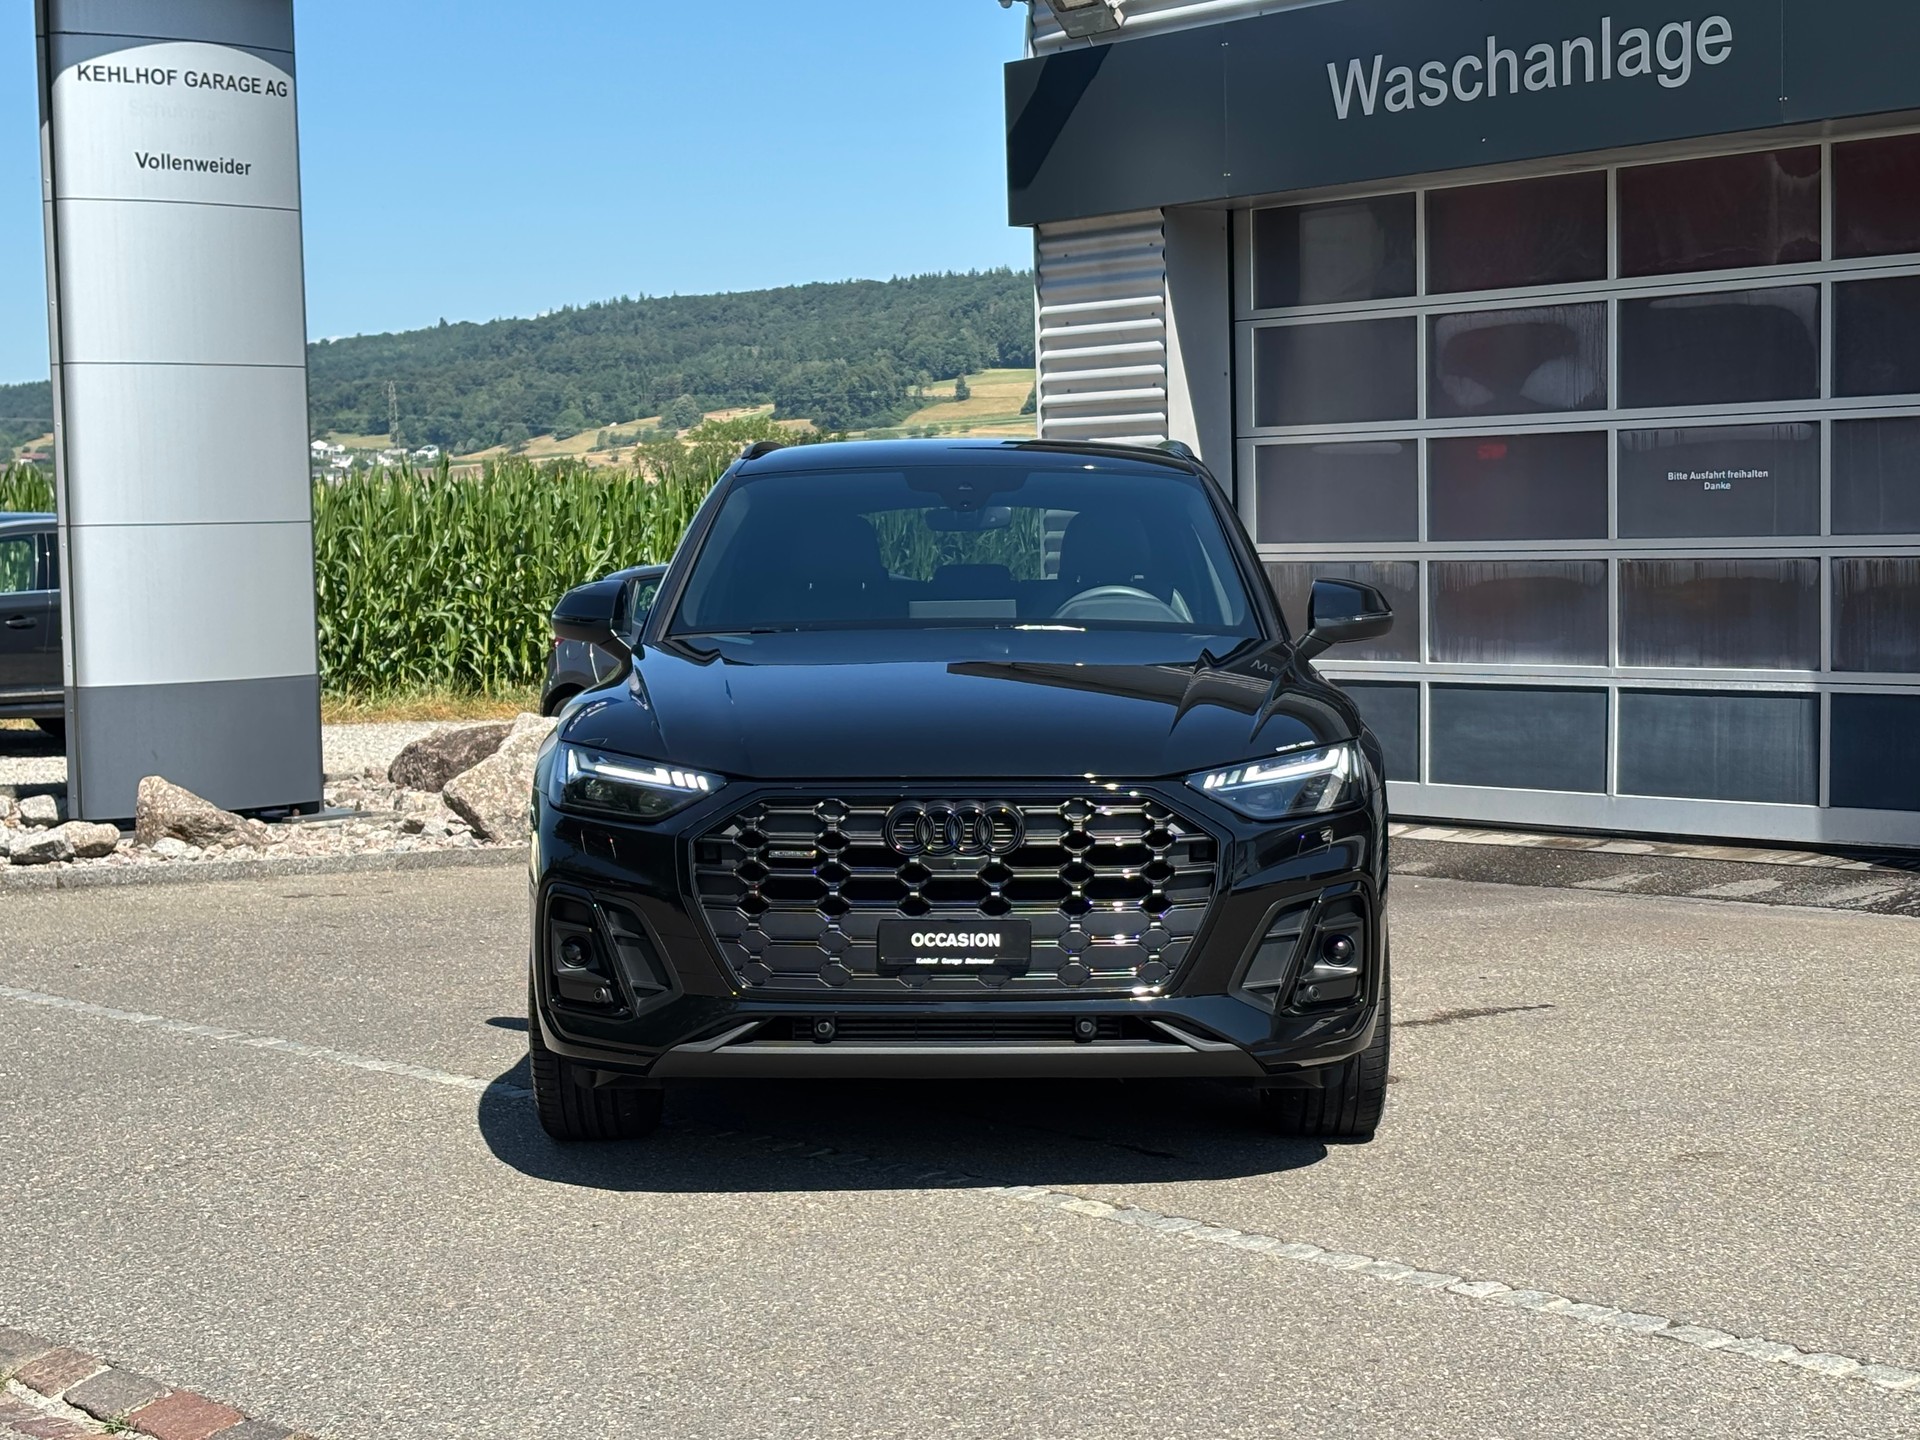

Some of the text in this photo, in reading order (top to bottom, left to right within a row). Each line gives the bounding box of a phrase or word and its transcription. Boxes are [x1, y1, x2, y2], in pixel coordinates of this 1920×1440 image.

[1327, 15, 1733, 120] Waschanlage
[77, 64, 288, 97] KEHLHOF GARAGE AG
[134, 152, 252, 175] Vollenweider
[1667, 469, 1769, 481] Bitte Ausfahrt freihalten
[1703, 481, 1731, 491] Danke
[911, 932, 1000, 947] OCCASION
